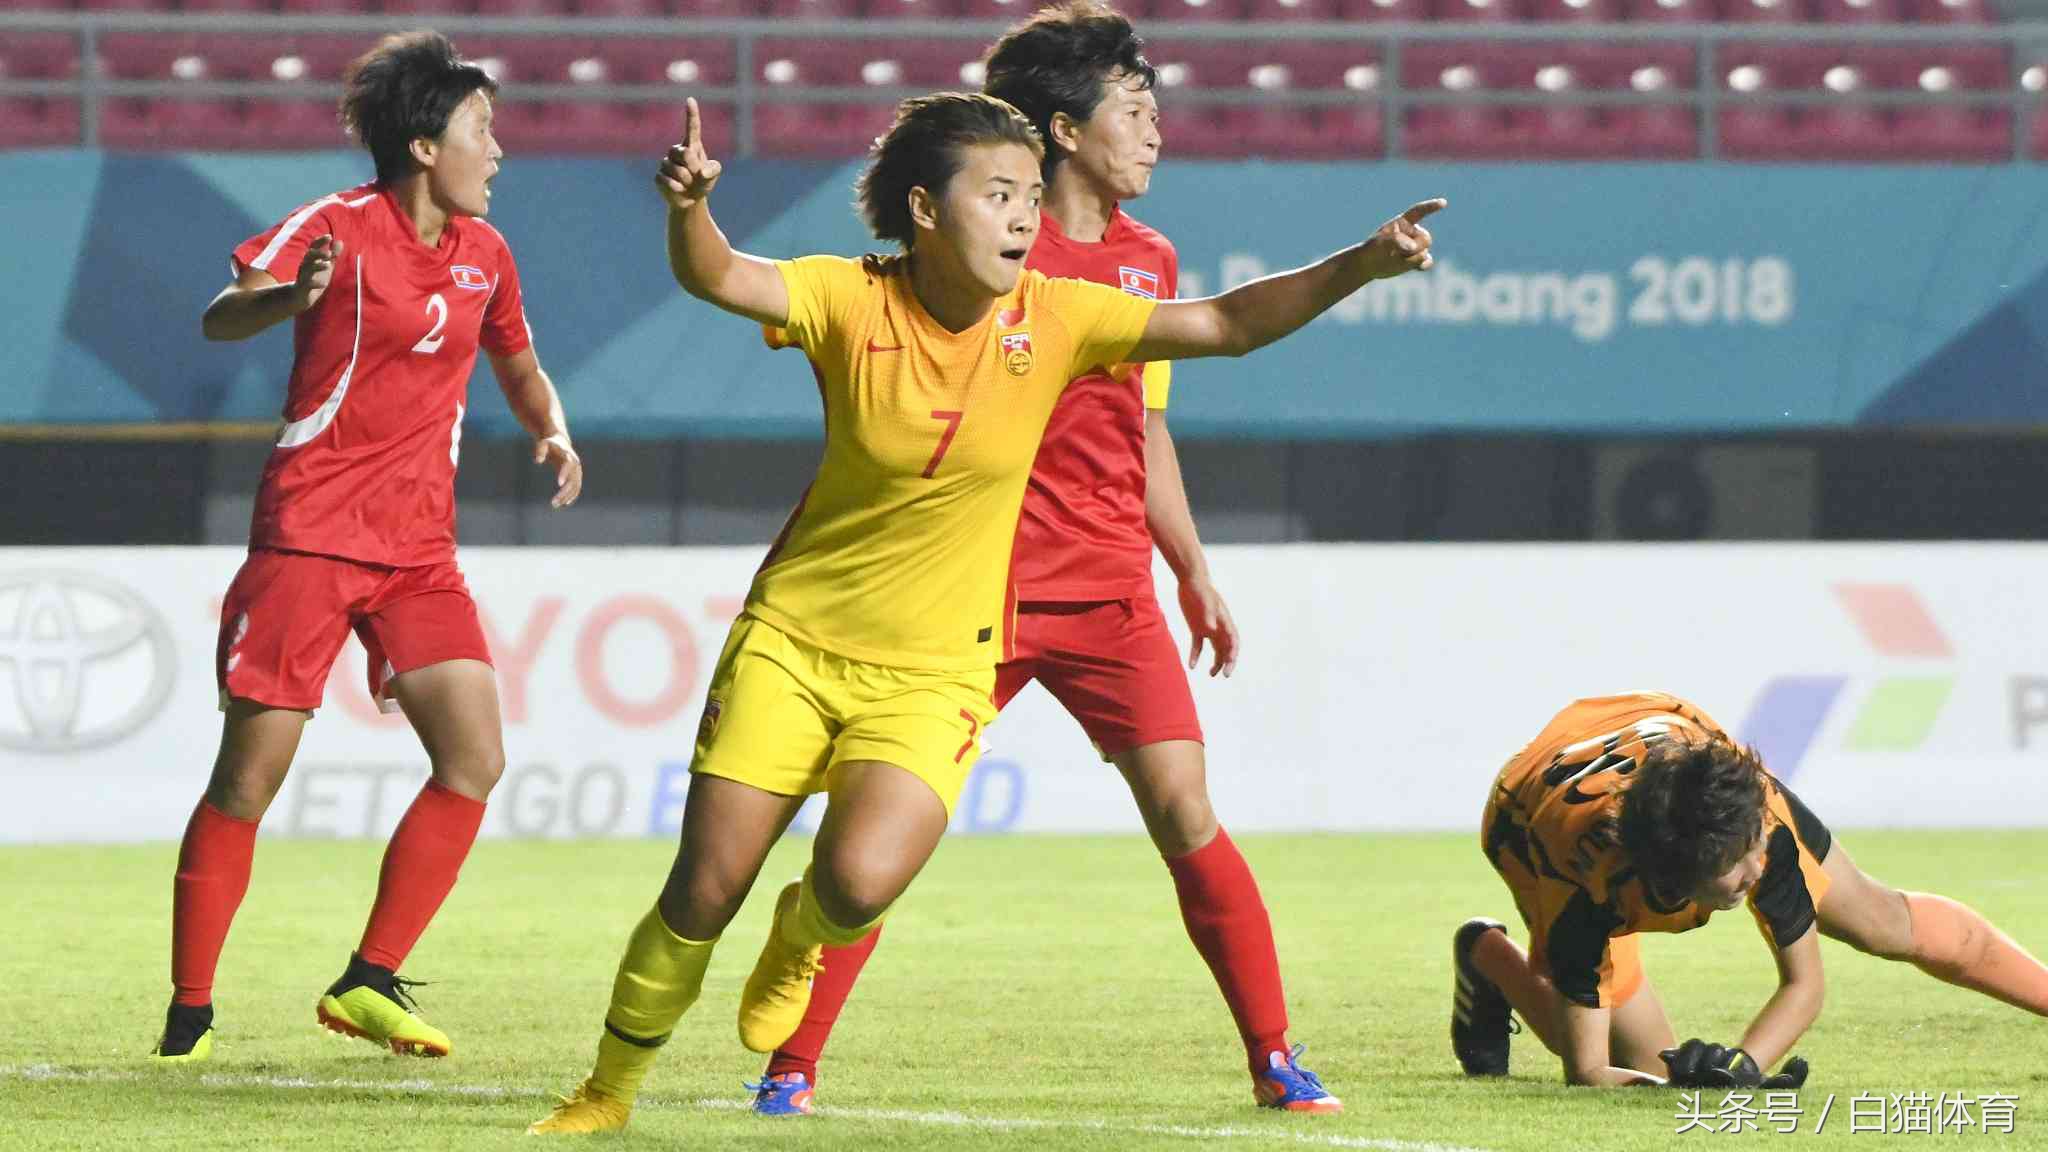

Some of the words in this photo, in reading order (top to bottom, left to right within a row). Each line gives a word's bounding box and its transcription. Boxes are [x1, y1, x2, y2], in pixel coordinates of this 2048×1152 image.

[411, 293, 448, 354] 2
[1629, 258, 1791, 324] 2018
[920, 410, 963, 479] 7
[954, 707, 978, 764] 7
[502, 762, 627, 838] GO
